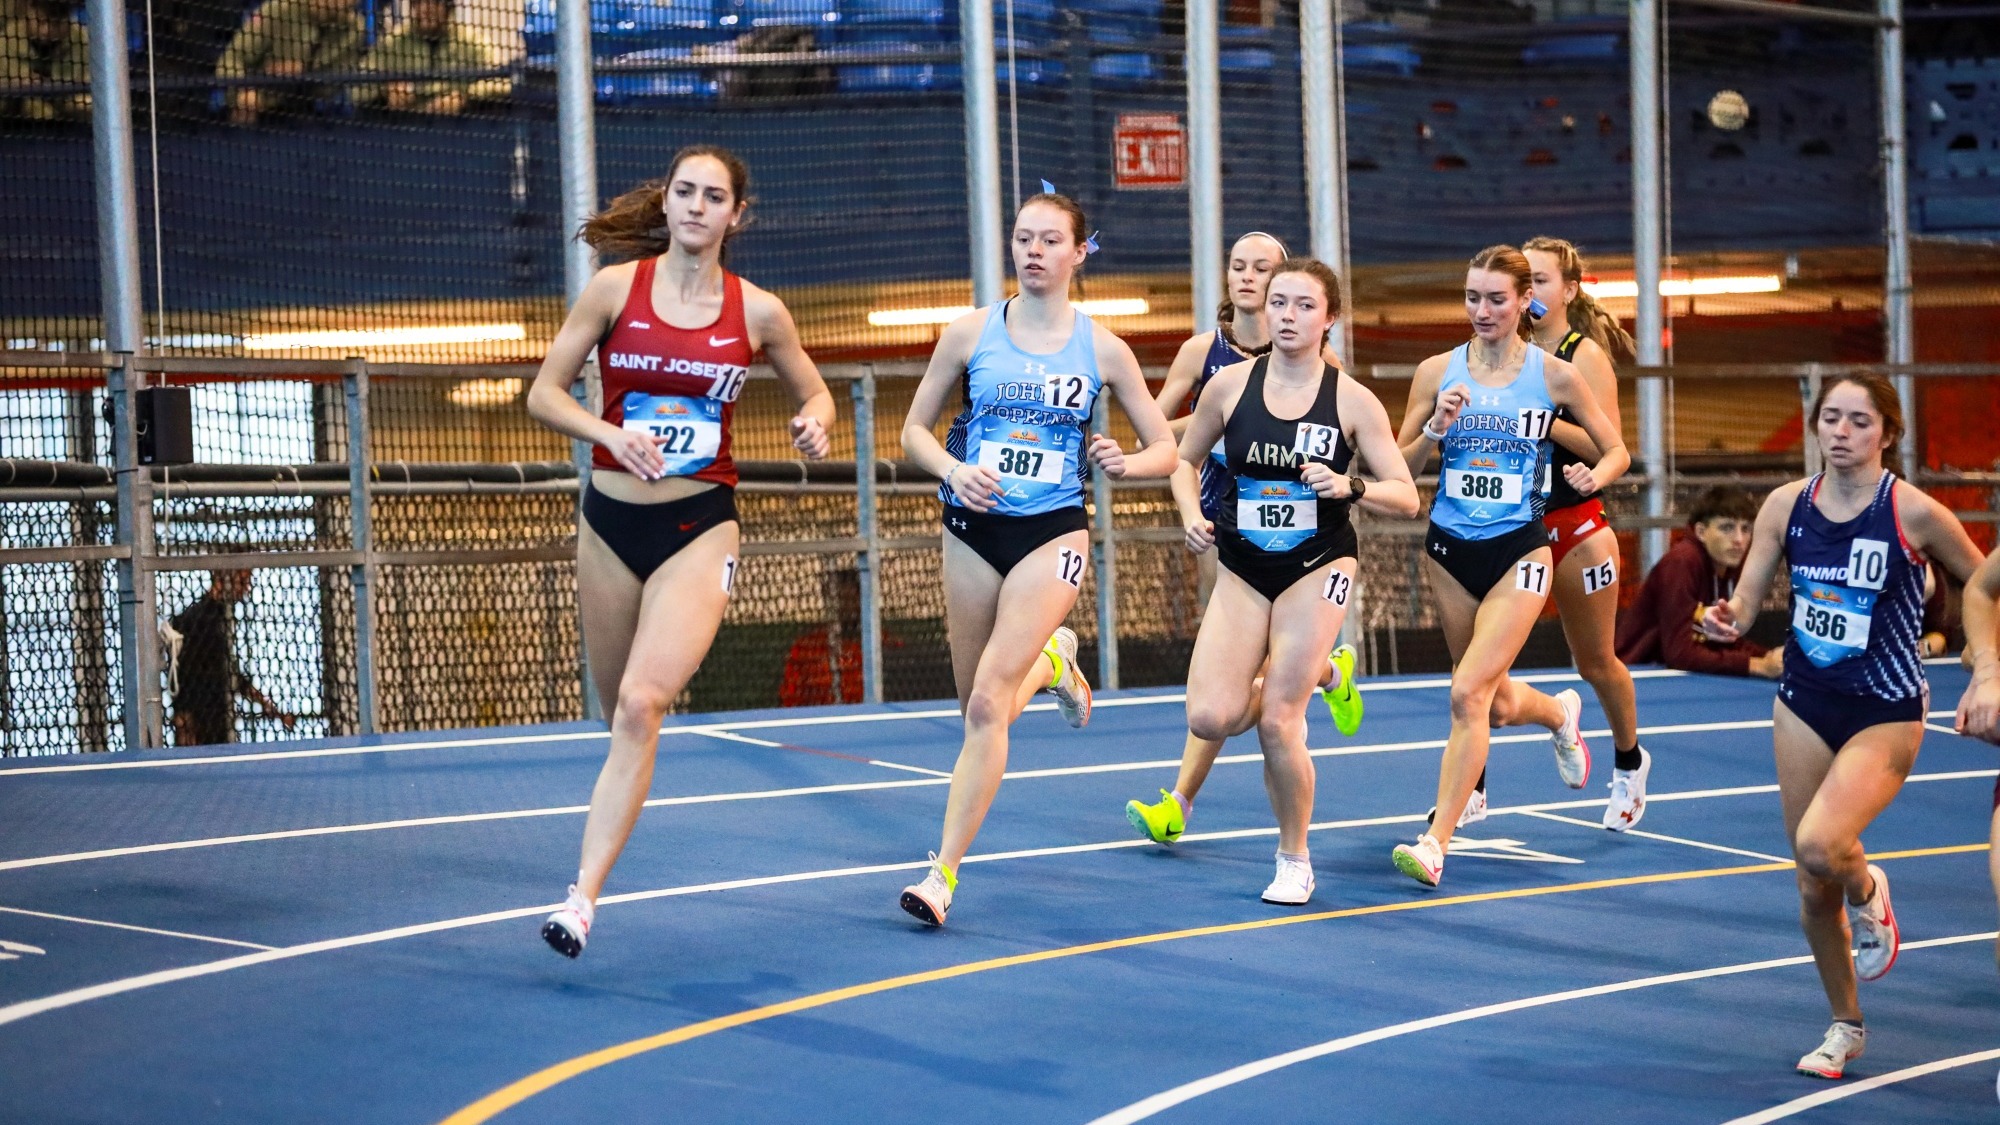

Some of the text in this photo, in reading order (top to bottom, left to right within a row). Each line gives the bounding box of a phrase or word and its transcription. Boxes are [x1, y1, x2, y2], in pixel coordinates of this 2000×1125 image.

[1119, 136, 1180, 175] EXIT
[610, 353, 662, 371] SAINT
[716, 367, 747, 400] 16
[1049, 376, 1083, 408] 12
[1456, 414, 1519, 437] JOHNS
[1521, 410, 1547, 437] 11
[650, 425, 696, 454] 722
[1301, 425, 1332, 456] 13
[1448, 436, 1532, 455] HOPKINS
[998, 447, 1044, 478] 387
[1461, 474, 1503, 499] 388
[1257, 504, 1295, 528] 152
[1062, 549, 1082, 587] 12
[1520, 562, 1545, 593] 11
[1585, 561, 1612, 591] 15
[1853, 549, 1883, 582] 10
[1327, 572, 1349, 605] 13
[1805, 604, 1847, 641] 536
